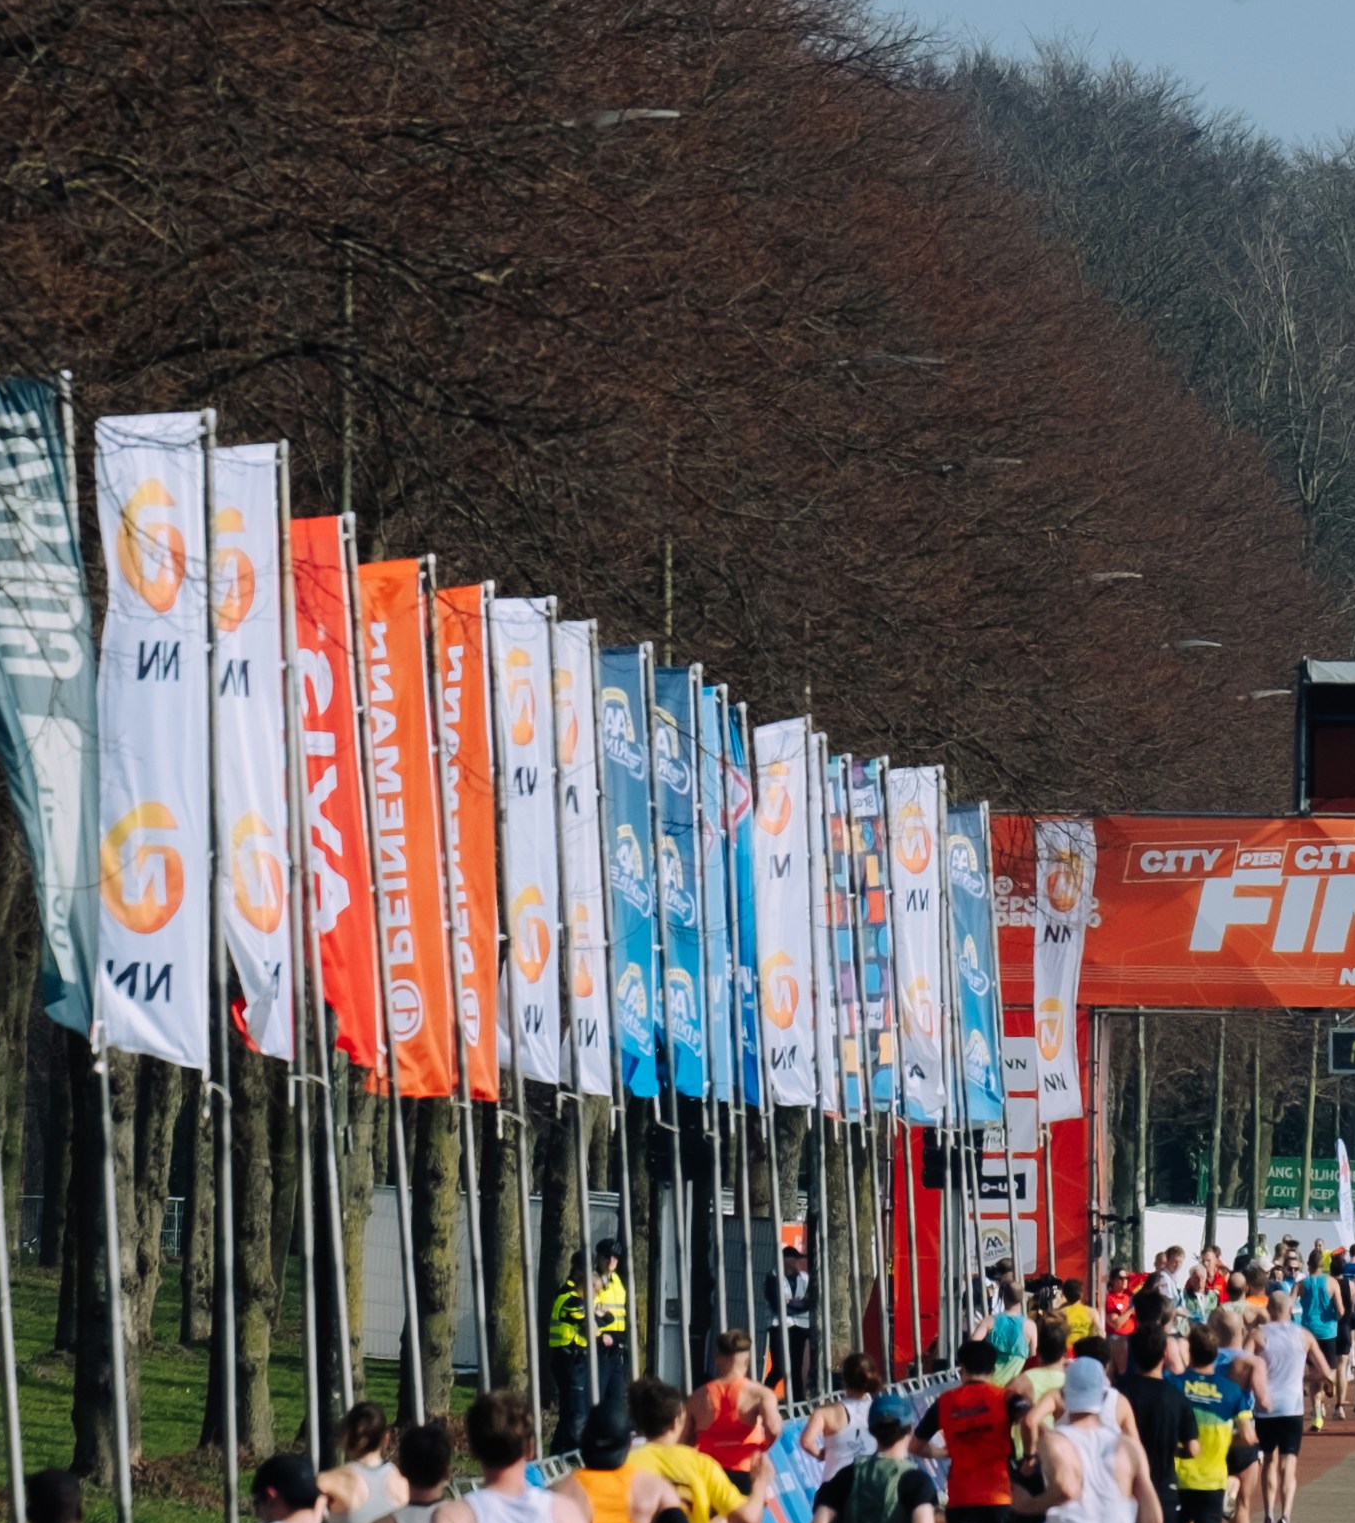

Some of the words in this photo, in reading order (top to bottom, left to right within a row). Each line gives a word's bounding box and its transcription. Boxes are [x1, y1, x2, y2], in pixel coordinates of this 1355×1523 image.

[1140, 848, 1223, 873] CITY
[1239, 851, 1282, 866] PIER
[1273, 1185, 1297, 1198] EXIT
[1184, 1379, 1223, 1399] NSL
